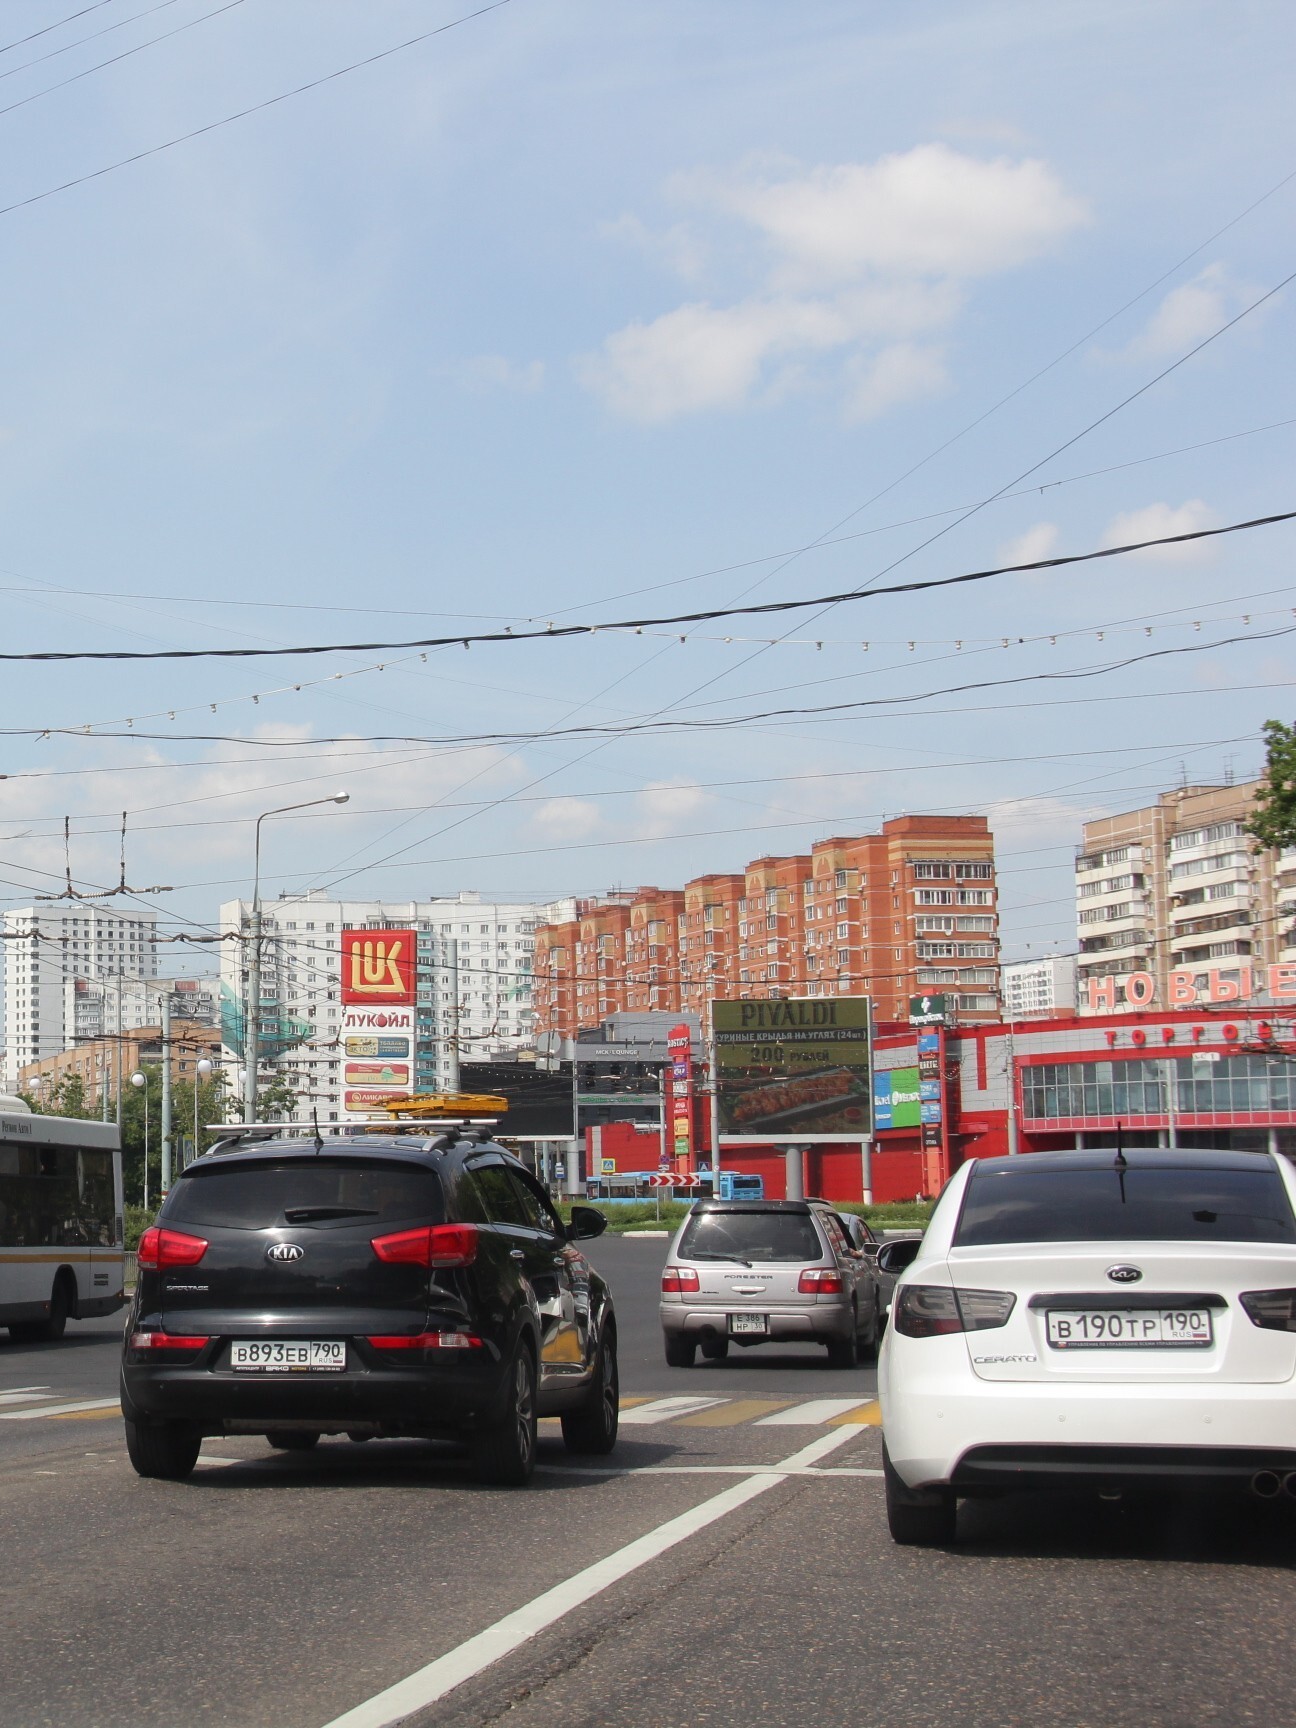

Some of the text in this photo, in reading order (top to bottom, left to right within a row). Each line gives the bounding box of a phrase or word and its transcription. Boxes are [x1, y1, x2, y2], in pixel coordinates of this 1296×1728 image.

[1088, 963, 1296, 1009] НОВЫЕ
[741, 1001, 838, 1027] PIVALDI
[714, 1033, 754, 1042] КУРИНЫЕ
[756, 1032, 792, 1041] КРЫЛЬЯ
[794, 1031, 805, 1040] НА
[808, 1031, 835, 1039] УГЛЯХ
[1105, 1022, 1296, 1046] ТОРГОВ
[751, 1047, 830, 1062] 200 РУБЛЕЙ
[273, 1248, 298, 1259] KIA
[1164, 1312, 1200, 1331] 190
[313, 1343, 340, 1358] 790
[974, 1355, 1037, 1364] CERATO
